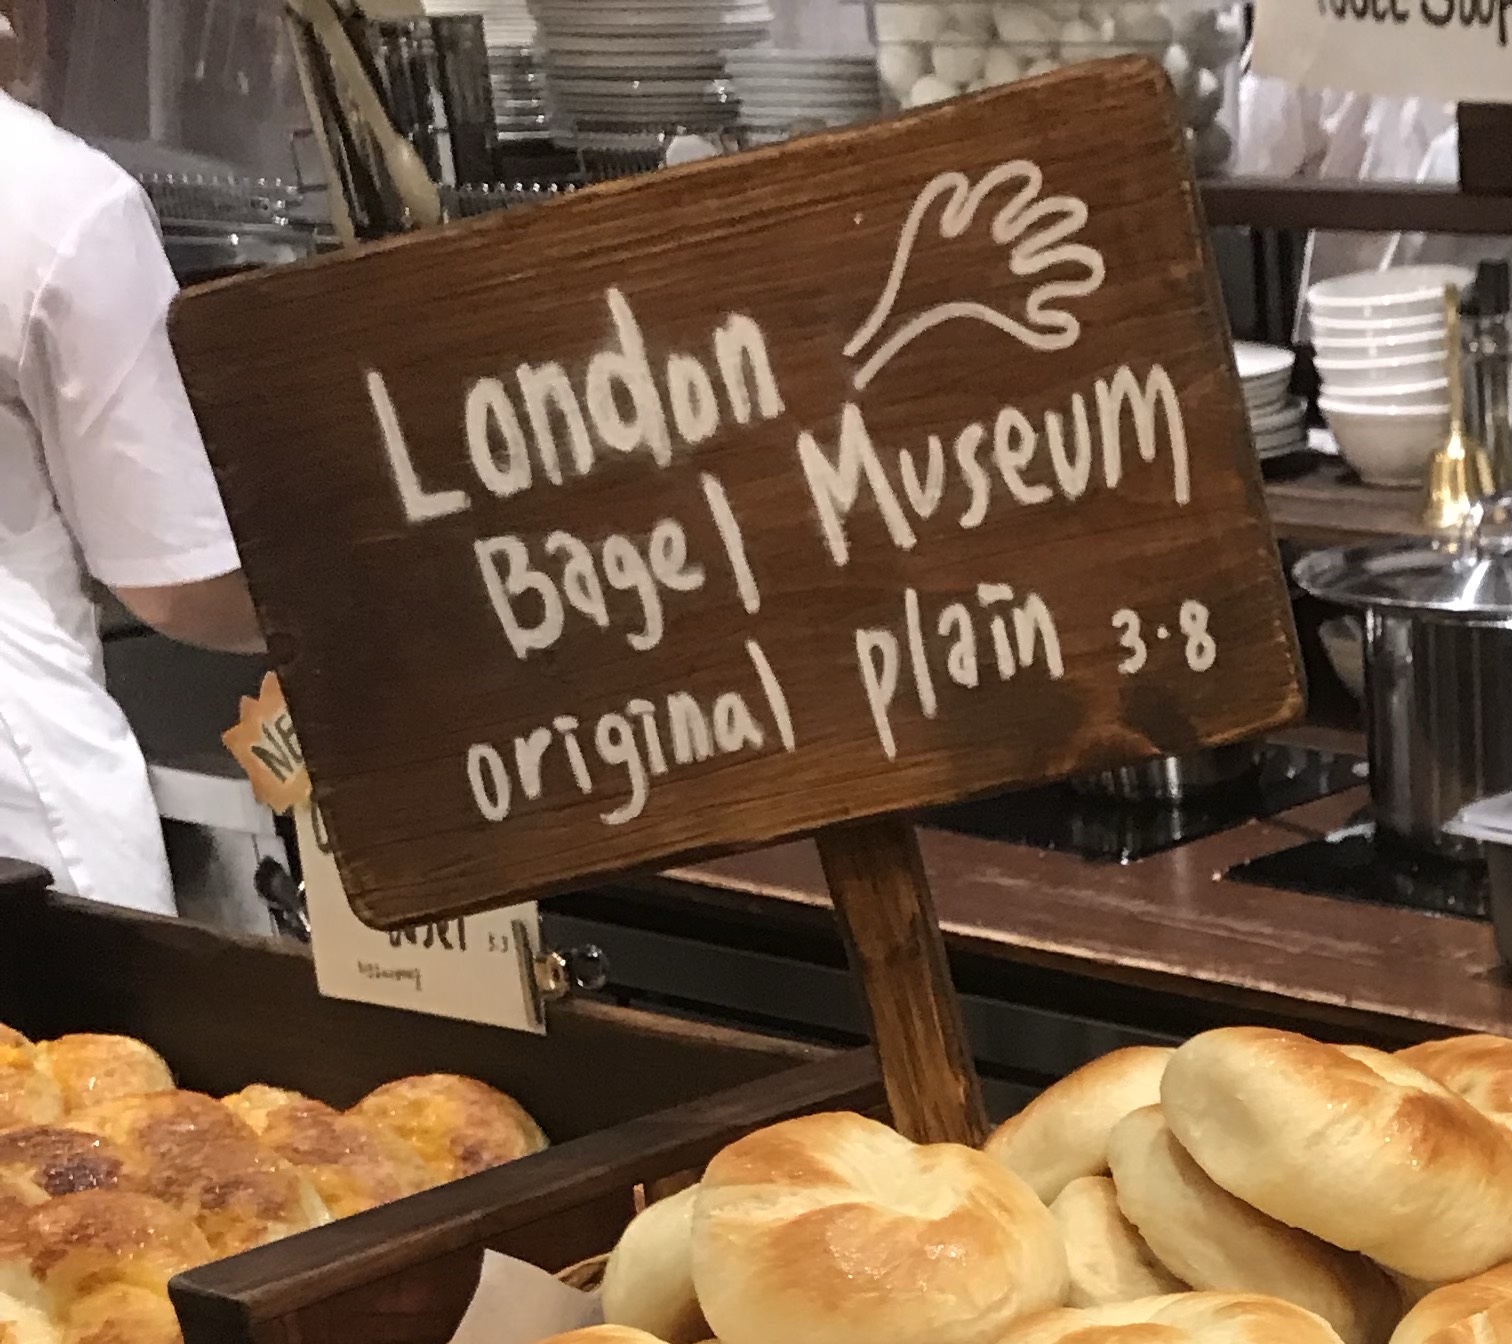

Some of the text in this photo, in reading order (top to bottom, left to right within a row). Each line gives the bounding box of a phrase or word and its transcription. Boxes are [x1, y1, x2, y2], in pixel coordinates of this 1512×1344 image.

[367, 287, 785, 521] London
[474, 363, 1190, 658] Bagel Museum
[251, 713, 304, 784] NE
[466, 640, 795, 825] original
[855, 583, 1064, 759] plain
